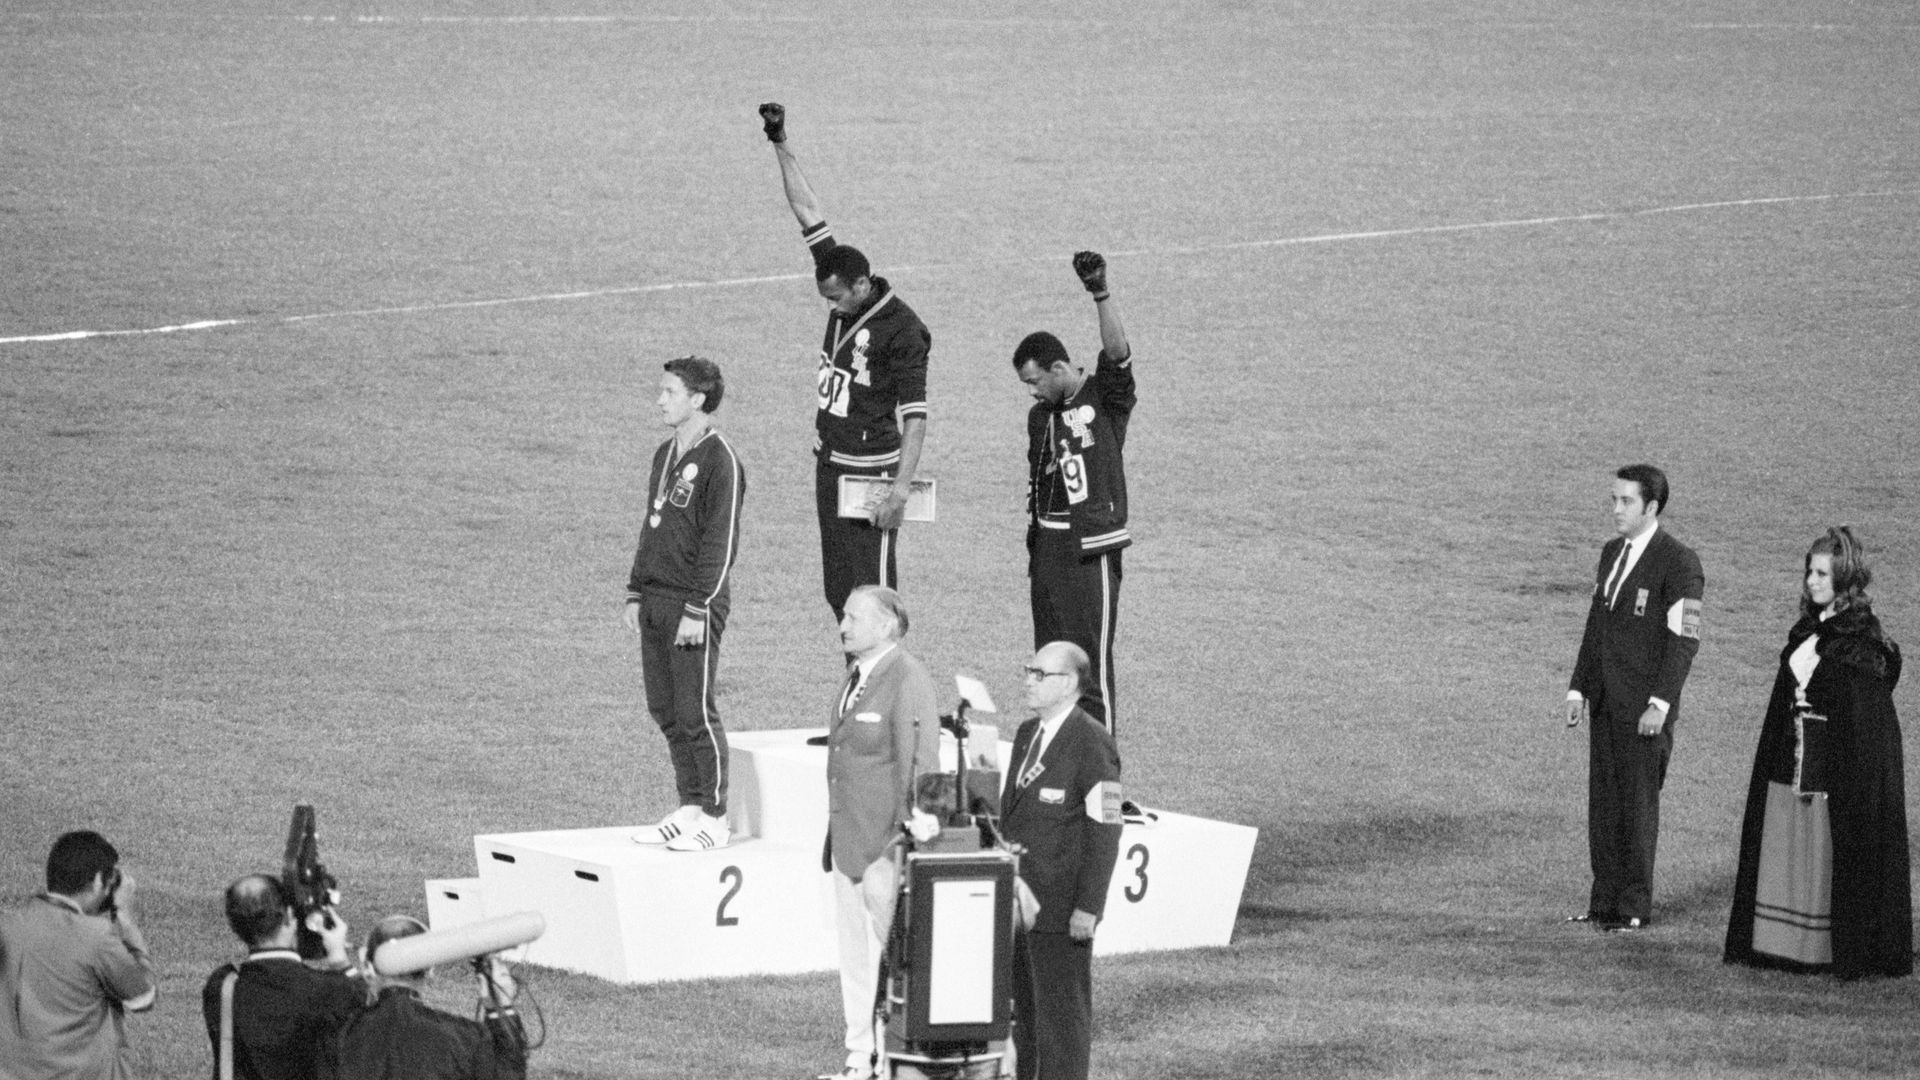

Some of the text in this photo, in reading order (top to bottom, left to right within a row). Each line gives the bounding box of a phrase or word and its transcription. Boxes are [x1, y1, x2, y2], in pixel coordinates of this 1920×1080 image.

[1063, 458, 1083, 493] 9
[716, 865, 743, 927] 2
[1124, 843, 1150, 903] 3
